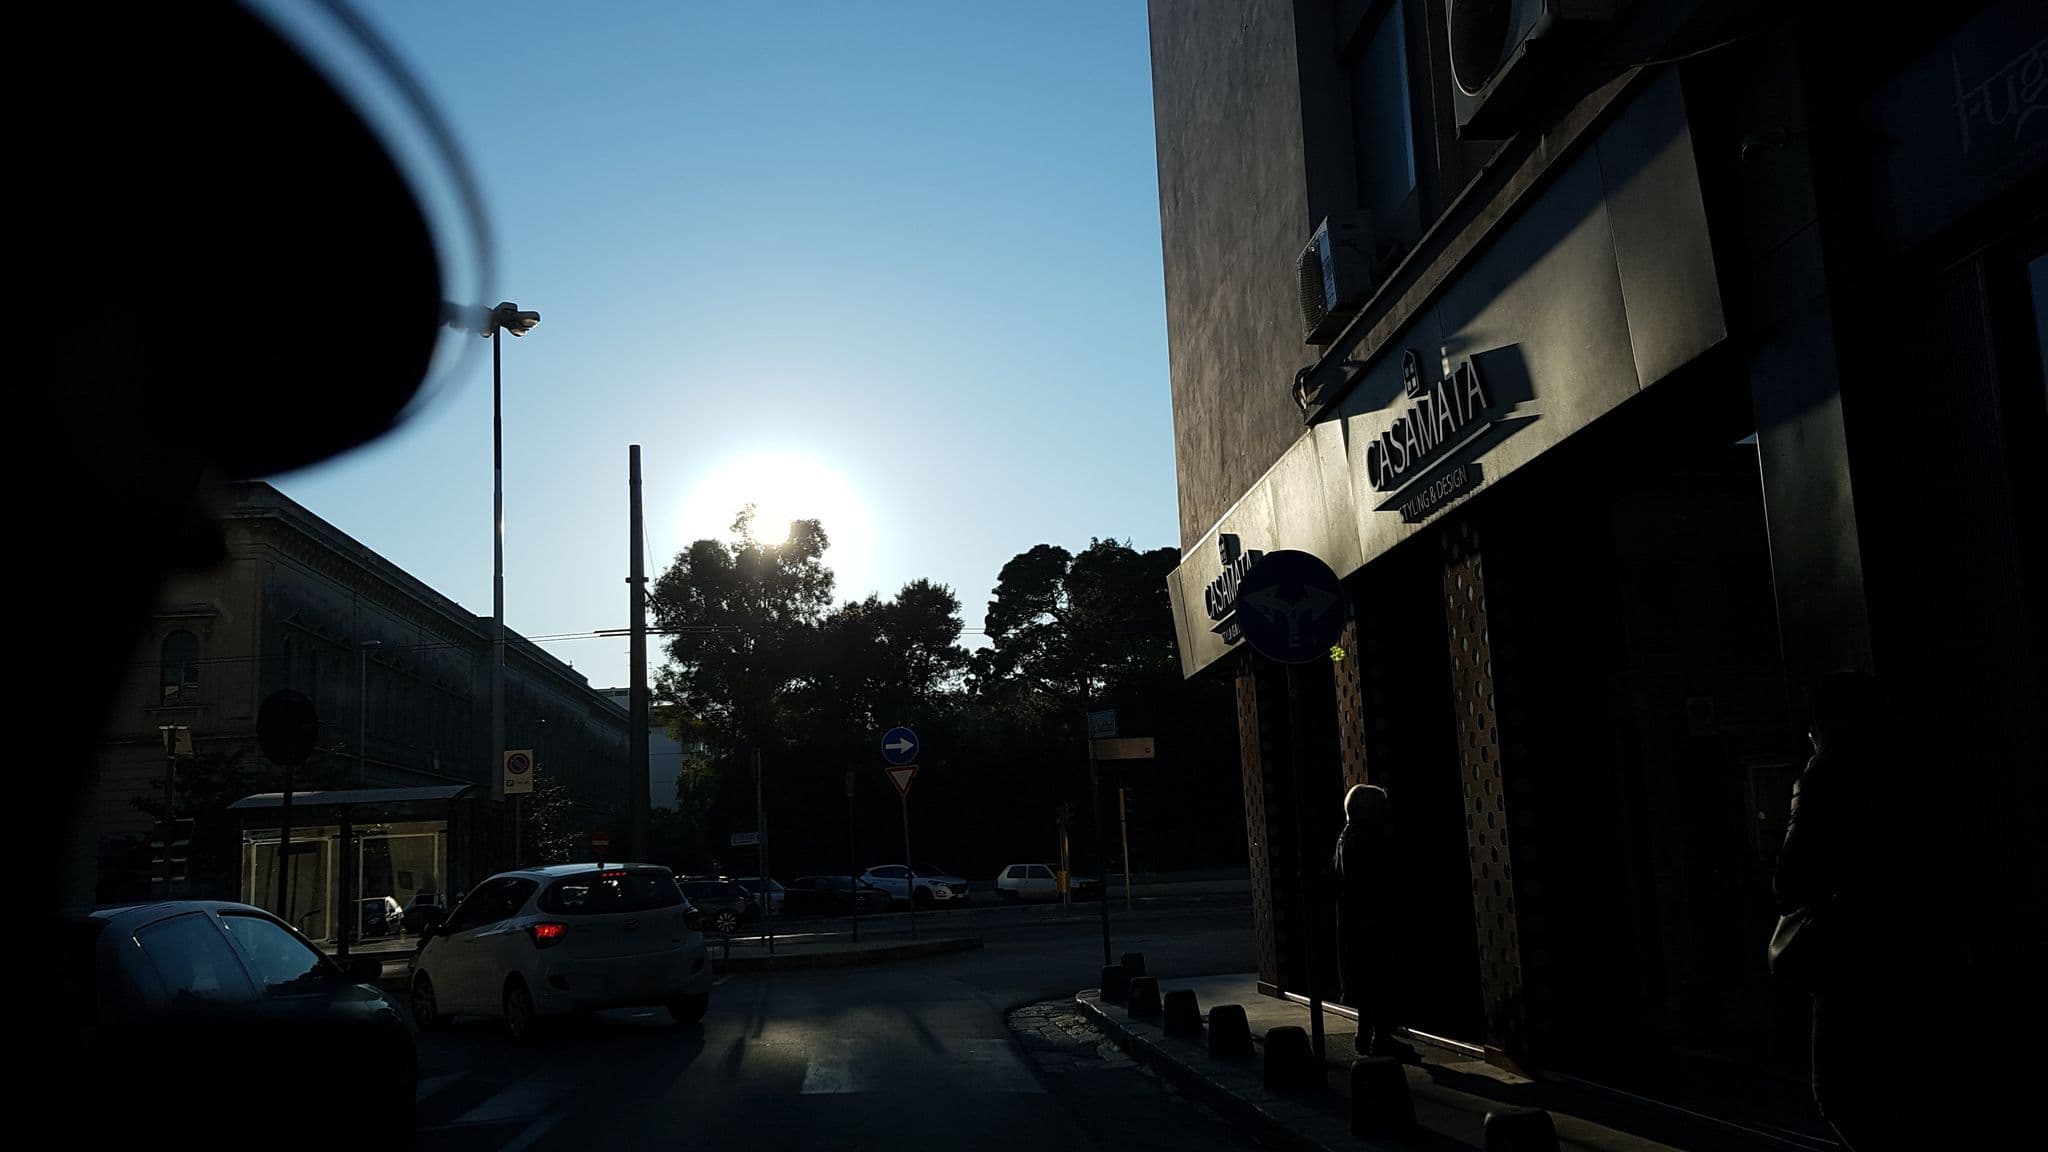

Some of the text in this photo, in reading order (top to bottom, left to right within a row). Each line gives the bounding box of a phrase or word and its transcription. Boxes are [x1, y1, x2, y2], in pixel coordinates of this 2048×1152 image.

[1367, 354, 1487, 492] CASAMATA
[1399, 464, 1468, 521] TYLING & DESIGN
